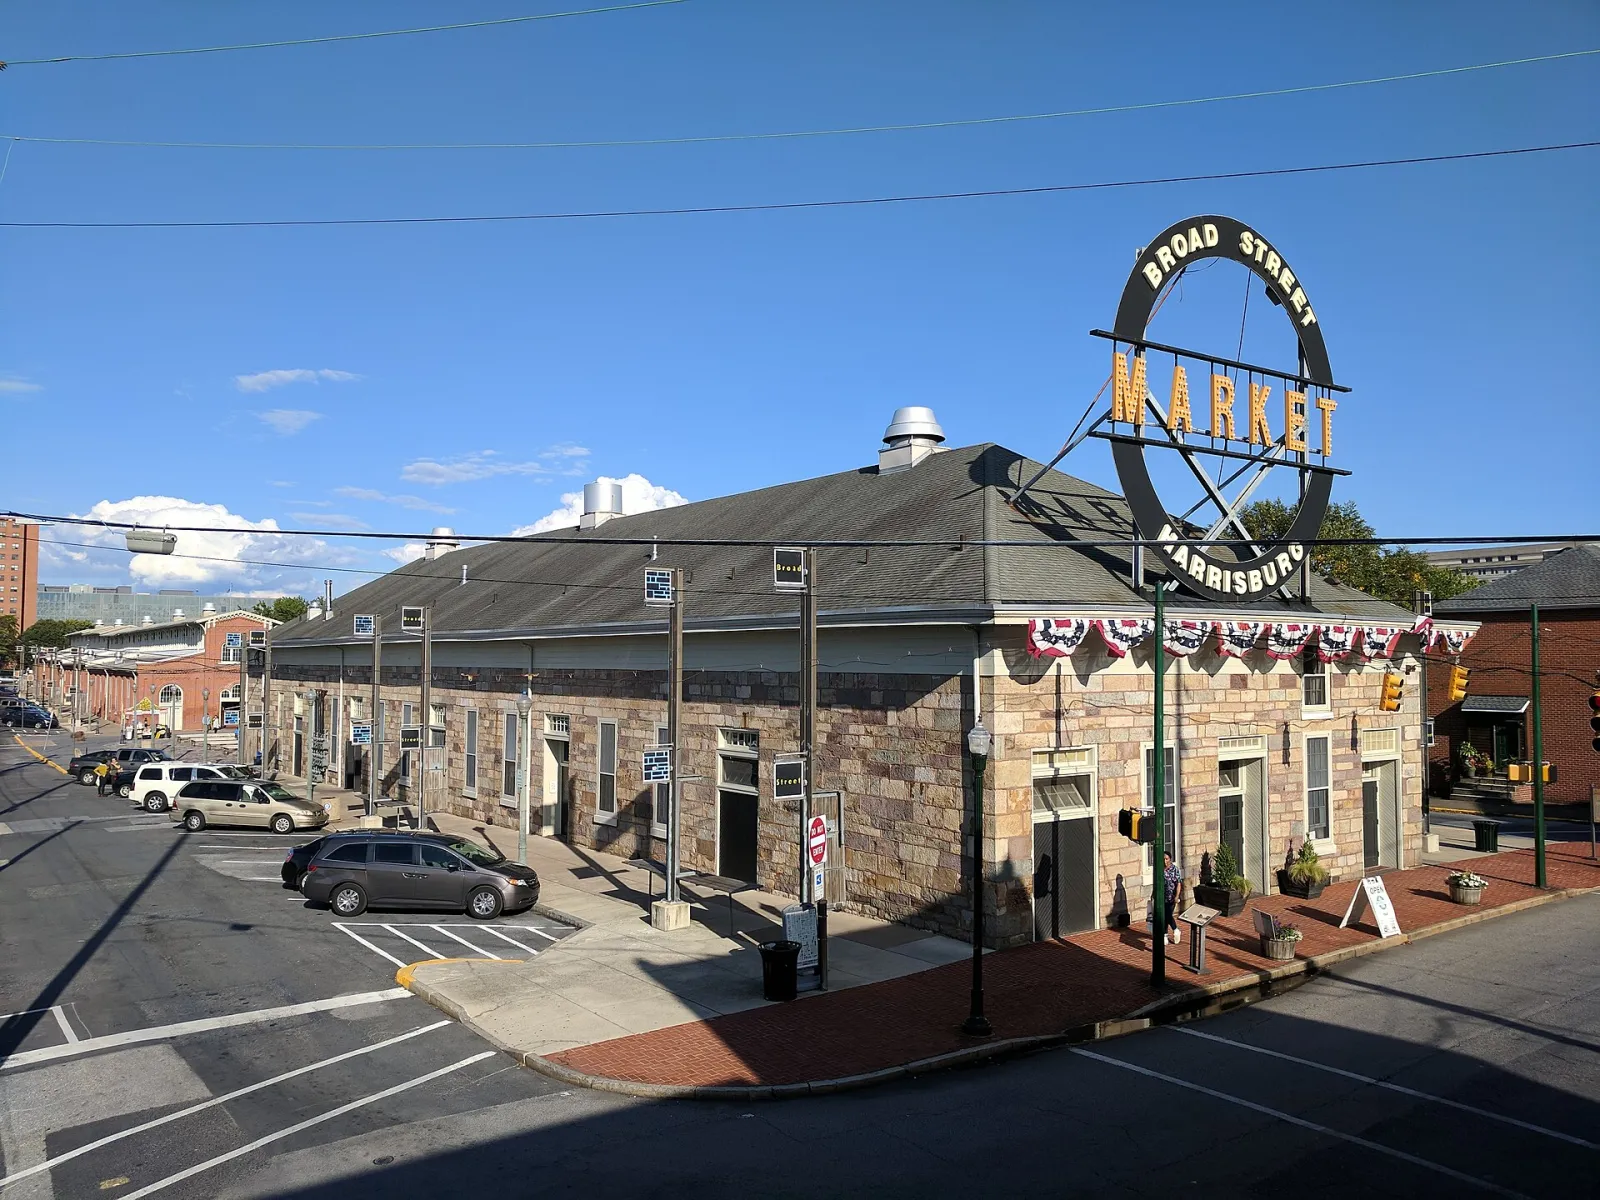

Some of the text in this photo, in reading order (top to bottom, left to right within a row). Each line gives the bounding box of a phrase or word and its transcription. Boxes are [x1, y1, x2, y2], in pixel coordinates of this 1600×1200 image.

[1141, 223, 1317, 327] BROAD STREET
[1111, 352, 1338, 457] MARKET
[776, 563, 802, 572] Broad
[1156, 523, 1303, 595] HARRISBURG
[776, 777, 801, 786] Street
[811, 828, 817, 836] DO
